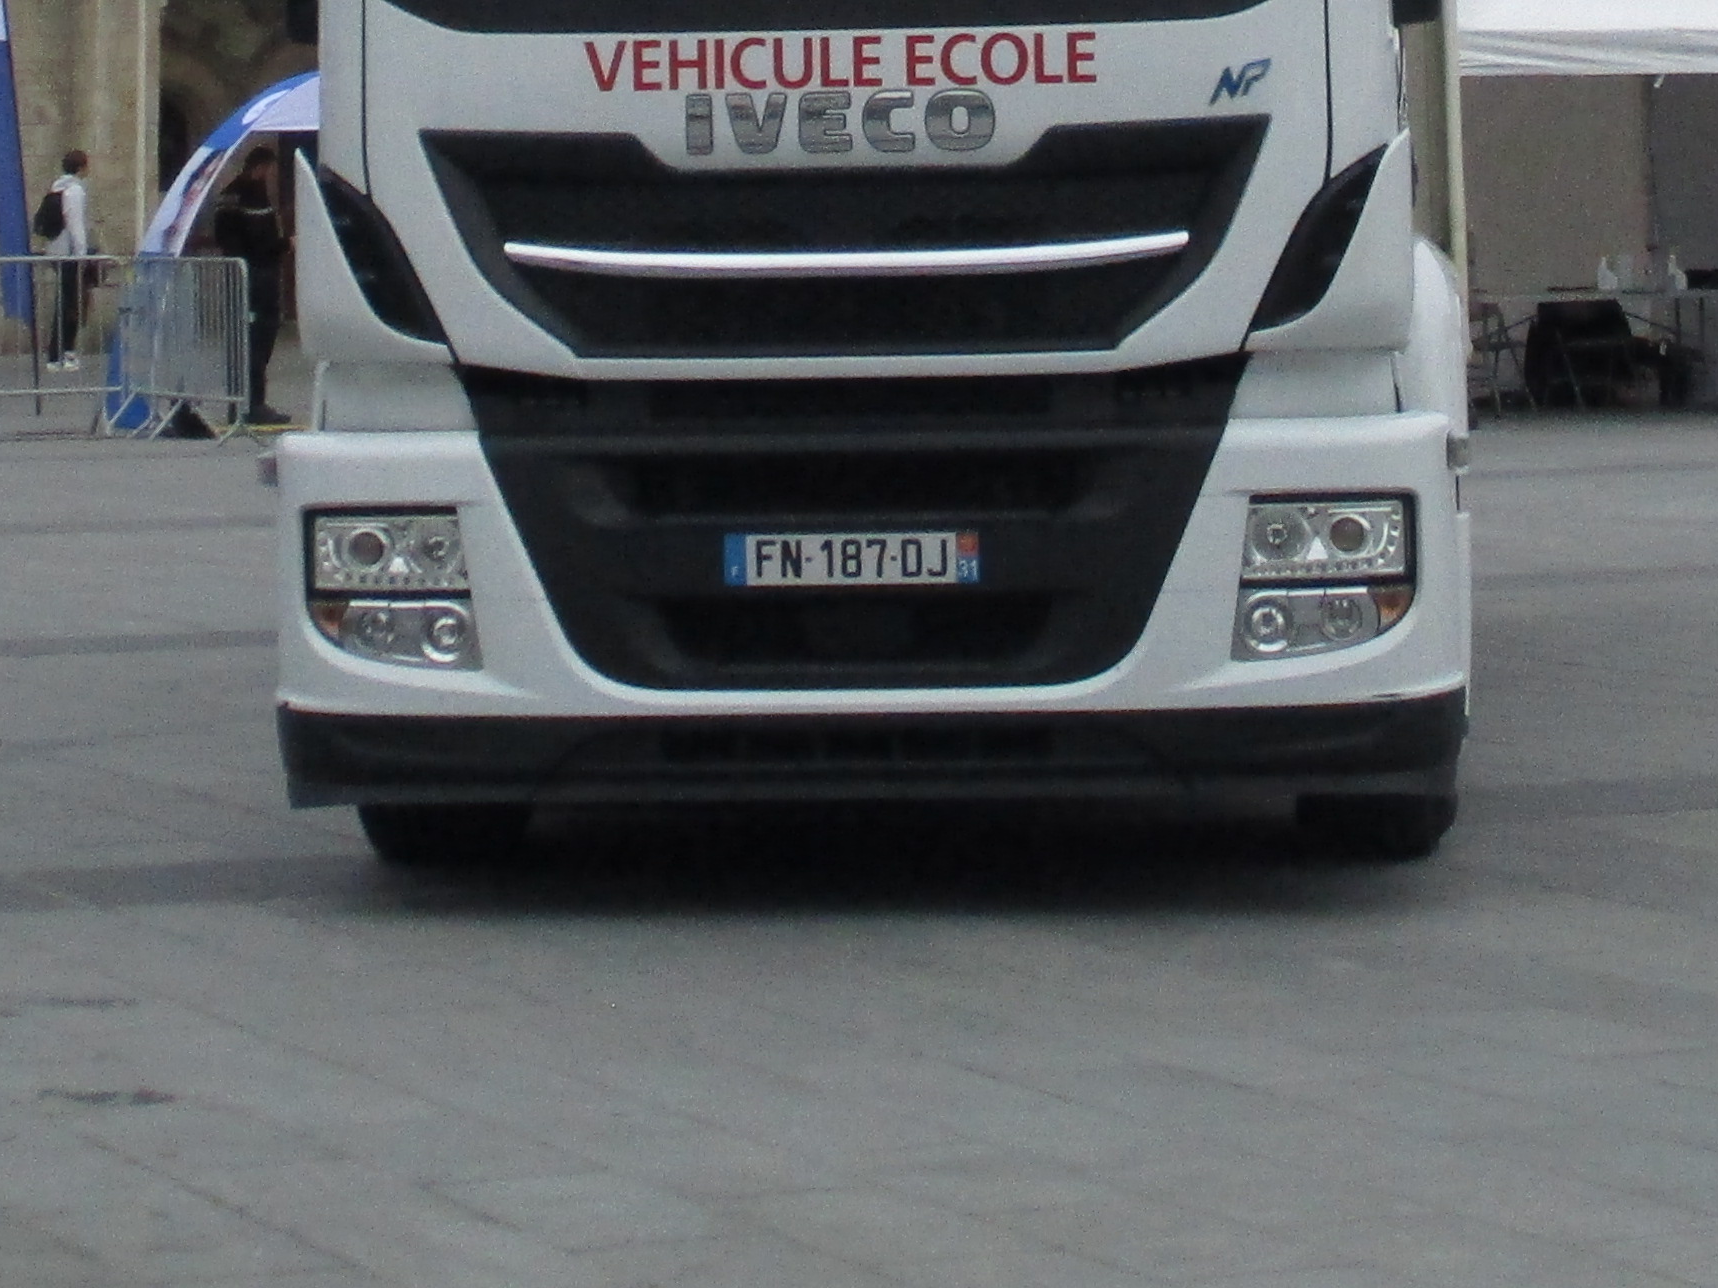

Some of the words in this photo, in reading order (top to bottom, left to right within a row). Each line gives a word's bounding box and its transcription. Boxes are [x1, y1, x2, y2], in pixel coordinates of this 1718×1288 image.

[584, 36, 882, 92] VEHICULE
[905, 32, 1097, 87] ECOLE
[685, 88, 996, 156] IVECO
